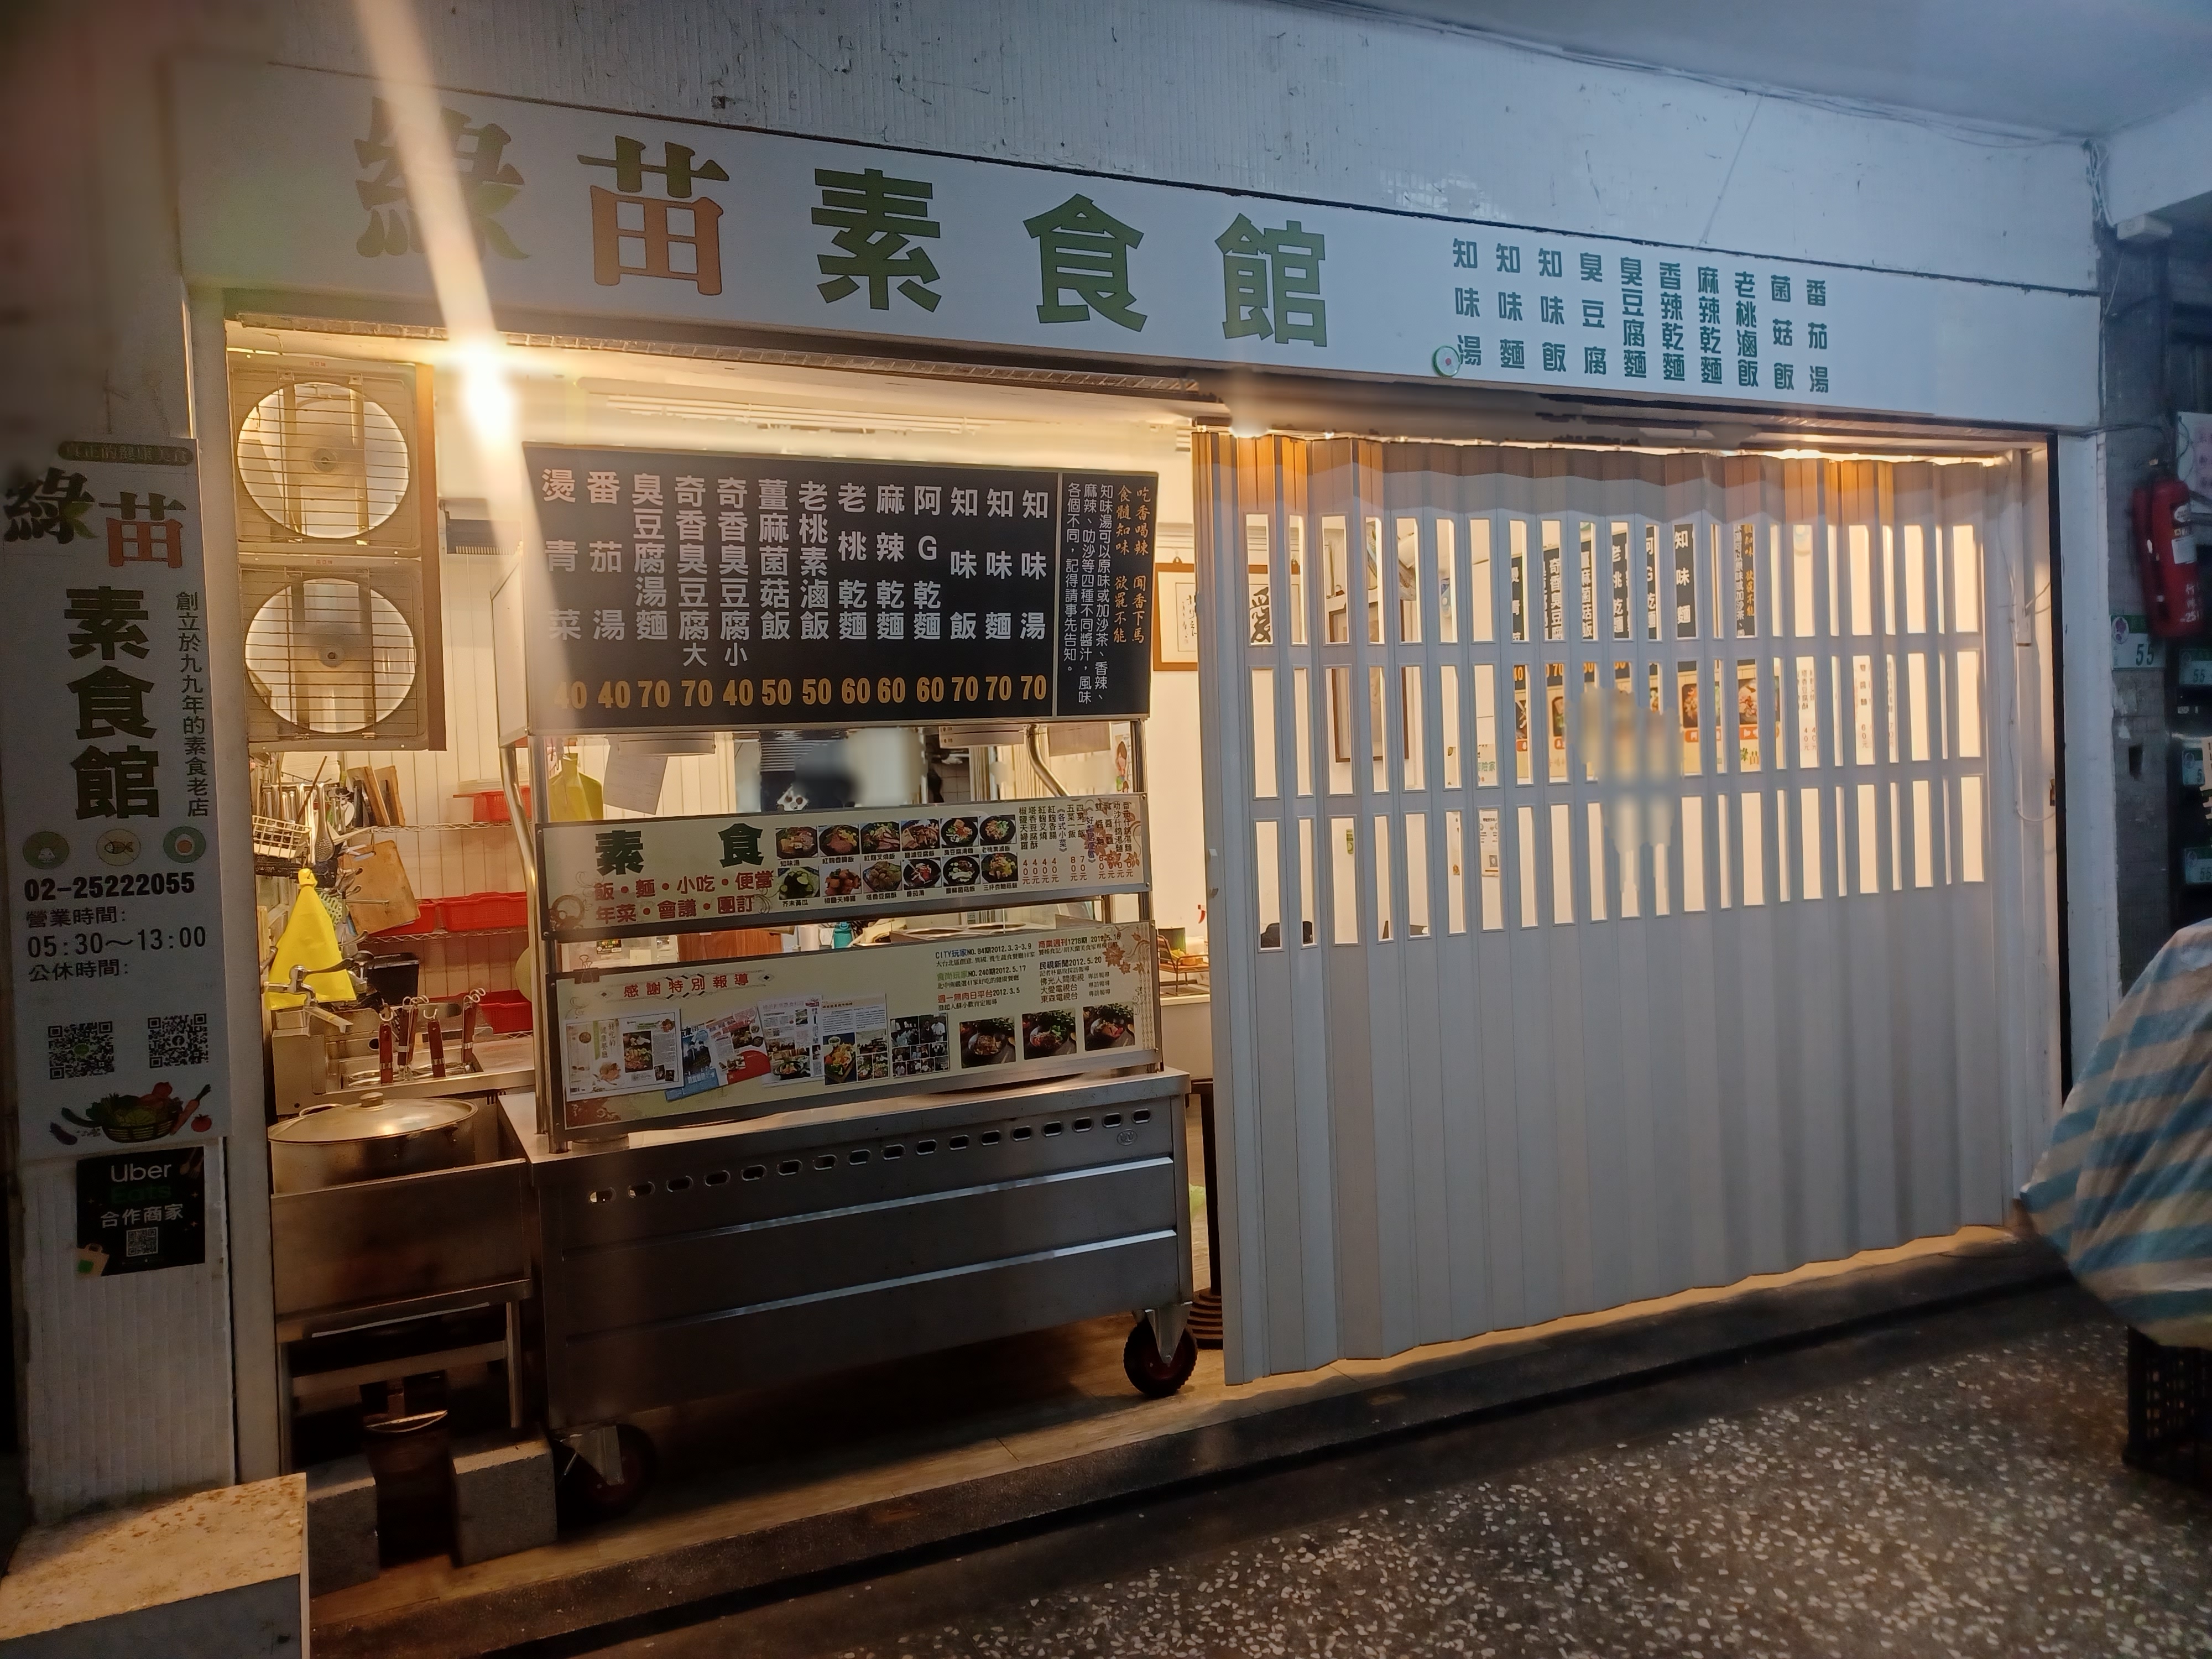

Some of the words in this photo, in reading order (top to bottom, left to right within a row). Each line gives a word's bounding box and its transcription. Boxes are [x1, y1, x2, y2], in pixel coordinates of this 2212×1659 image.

[1453, 238, 1481, 366] 知味湯
[1496, 243, 1525, 369] 知味麵
[1538, 248, 1566, 372] 知味飯
[1580, 252, 1606, 375] 臭豆腐
[1620, 257, 1646, 378] 臭豆腐麵
[1660, 262, 1685, 382] 香辣乾麵
[1697, 267, 1722, 385] 麻辣乾麵
[1735, 271, 1758, 388] 老桃滷飯
[1771, 275, 1794, 391] 菌菇飯
[1806, 279, 1829, 393] 番茄湯
[541, 469, 581, 640] 燙青菜
[587, 471, 625, 640] 番茄湯
[632, 473, 668, 641] 臭豆腐湯麵
[758, 479, 790, 640] 薑麻菌菇飯
[798, 481, 829, 640] 老桃素滷飯
[838, 482, 867, 640] 老桃乾麵
[876, 484, 905, 640] 麻辣乾麵
[914, 486, 941, 640] 阿G乾麵
[950, 487, 978, 640] 知味飯
[985, 488, 1013, 640] 知味麵
[1020, 490, 1048, 640] 知味湯
[1115, 484, 1132, 555] 食髓知味
[1134, 487, 1151, 556] 吃香喝辣
[1113, 576, 1128, 643] 欲罷不能
[1132, 575, 1147, 643] 聞香下馬
[1674, 530, 1691, 624] 知味麵
[64, 586, 159, 820] 素食館
[176, 591, 209, 817] 創立於九九年的素食老店
[554, 681, 587, 709] 40
[598, 680, 630, 708] 40
[638, 680, 670, 708] 70
[681, 679, 713, 707] 70
[723, 679, 753, 706] 40
[761, 679, 791, 706] 50
[802, 678, 831, 705] 50
[842, 678, 870, 704] 60
[878, 677, 905, 703] 60
[916, 677, 944, 702] 60
[951, 676, 978, 702] 70
[985, 676, 1011, 701] 70
[1021, 675, 1047, 700] 70
[24, 872, 195, 901] 02-25222055
[1022, 859, 1030, 885] 40元
[624, 973, 749, 998] 感謝特別報導
[101, 1204, 184, 1229] 合作商家
[111, 1163, 172, 1182] Uber
